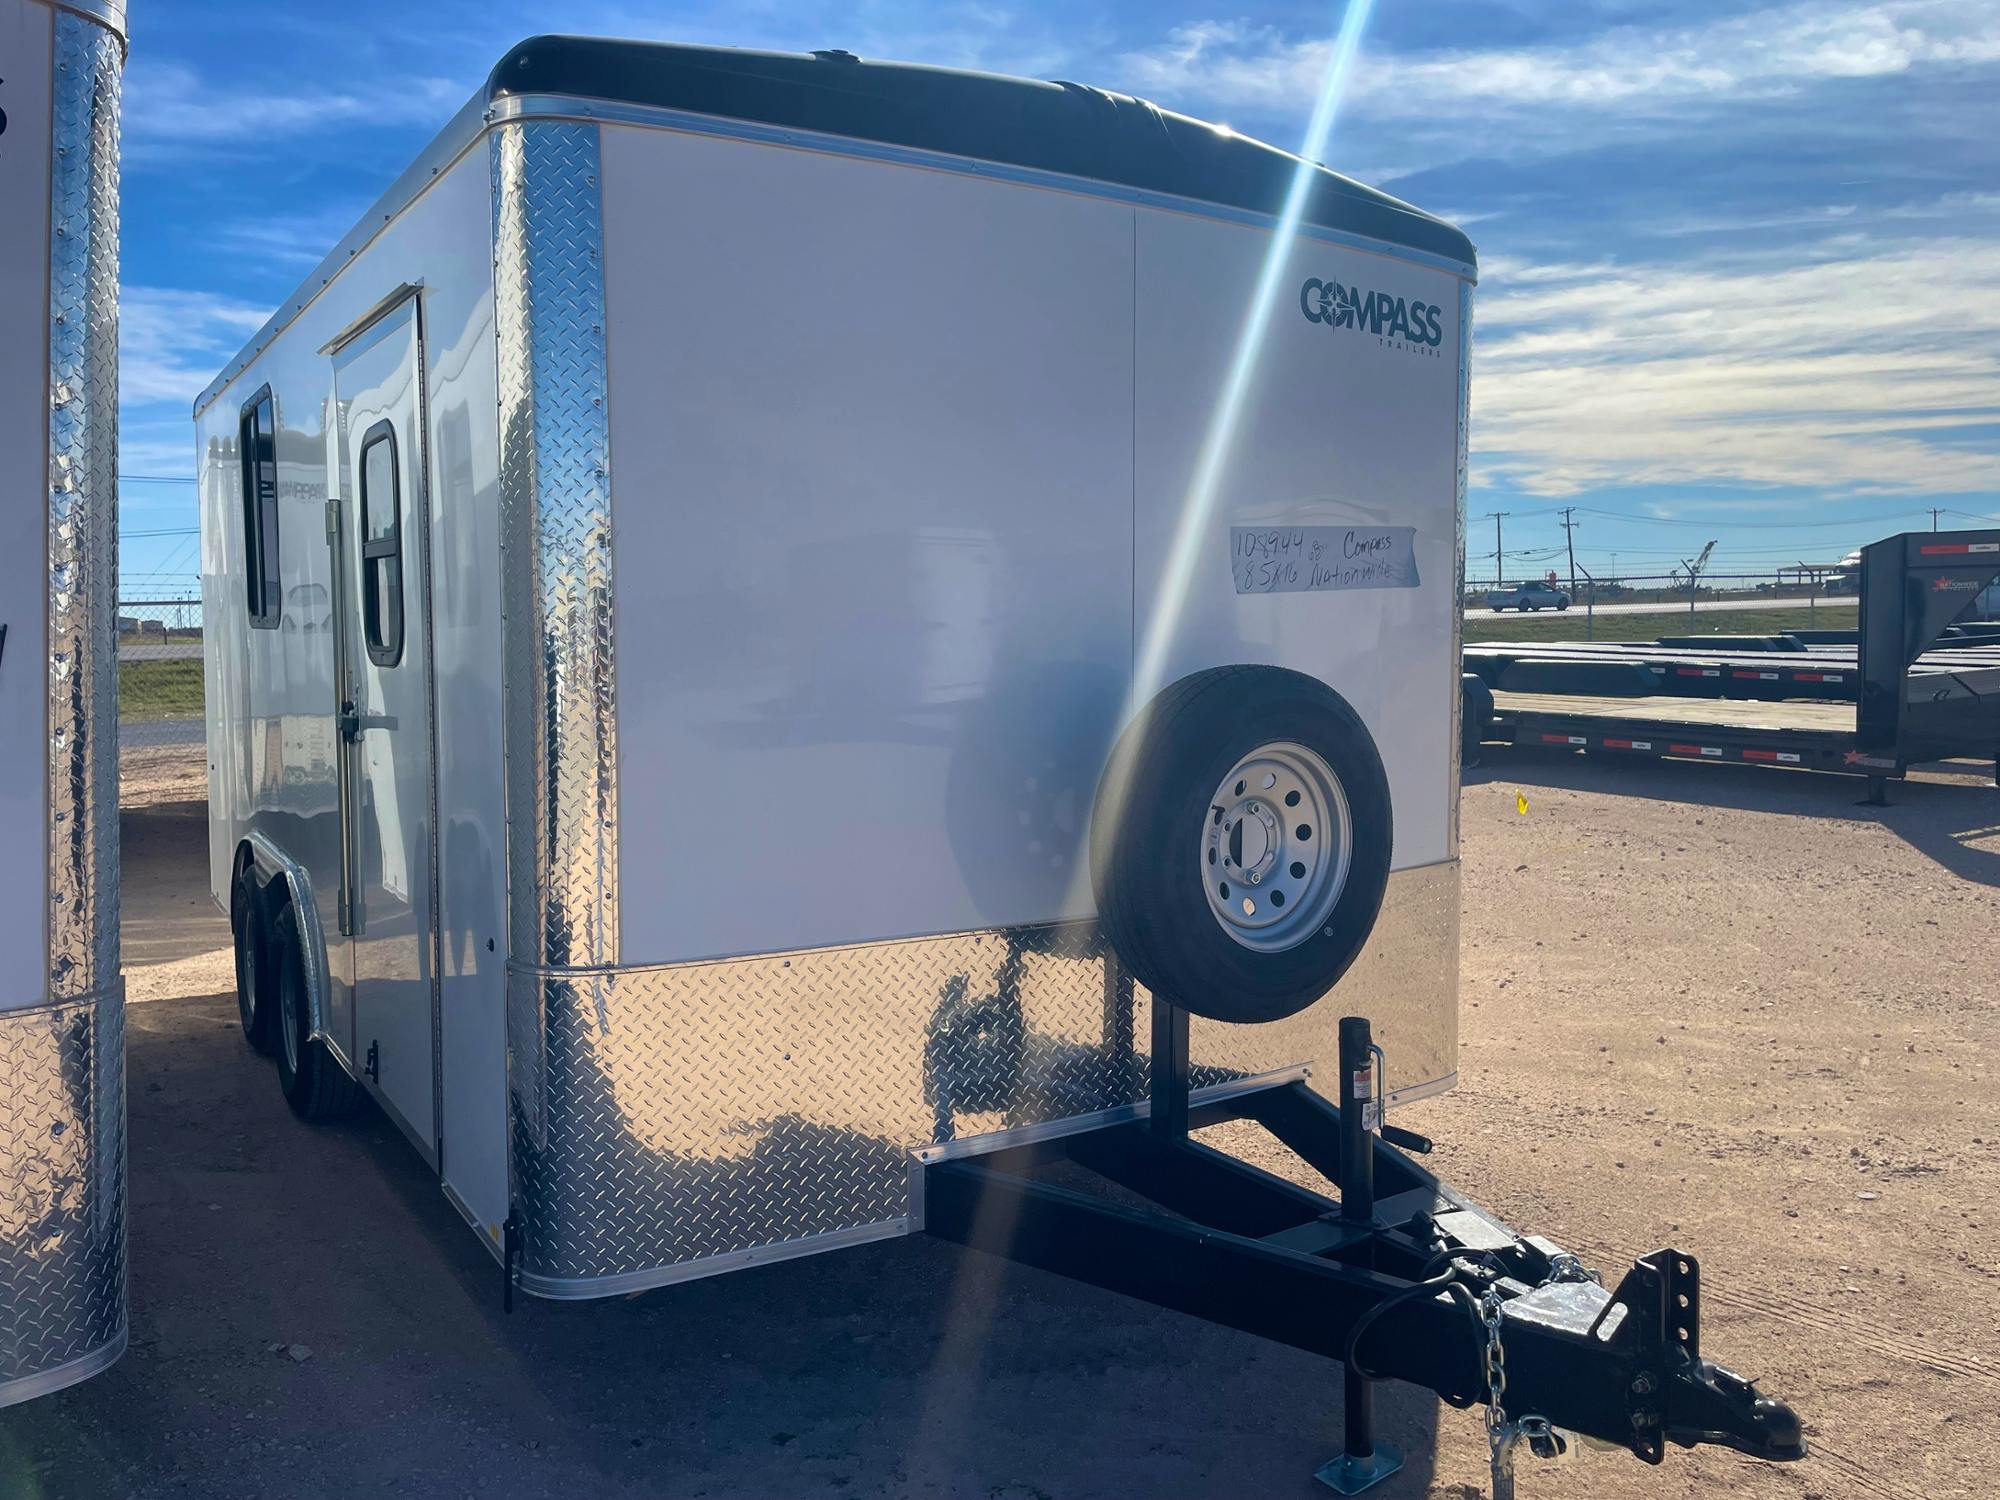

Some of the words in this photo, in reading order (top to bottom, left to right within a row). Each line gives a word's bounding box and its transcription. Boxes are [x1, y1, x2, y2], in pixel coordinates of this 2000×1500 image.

[1300, 277, 1442, 347] COMPASS
[1379, 338, 1441, 358] TRAILERS
[1237, 531, 1304, 558] 108944
[1343, 530, 1392, 559] Compass
